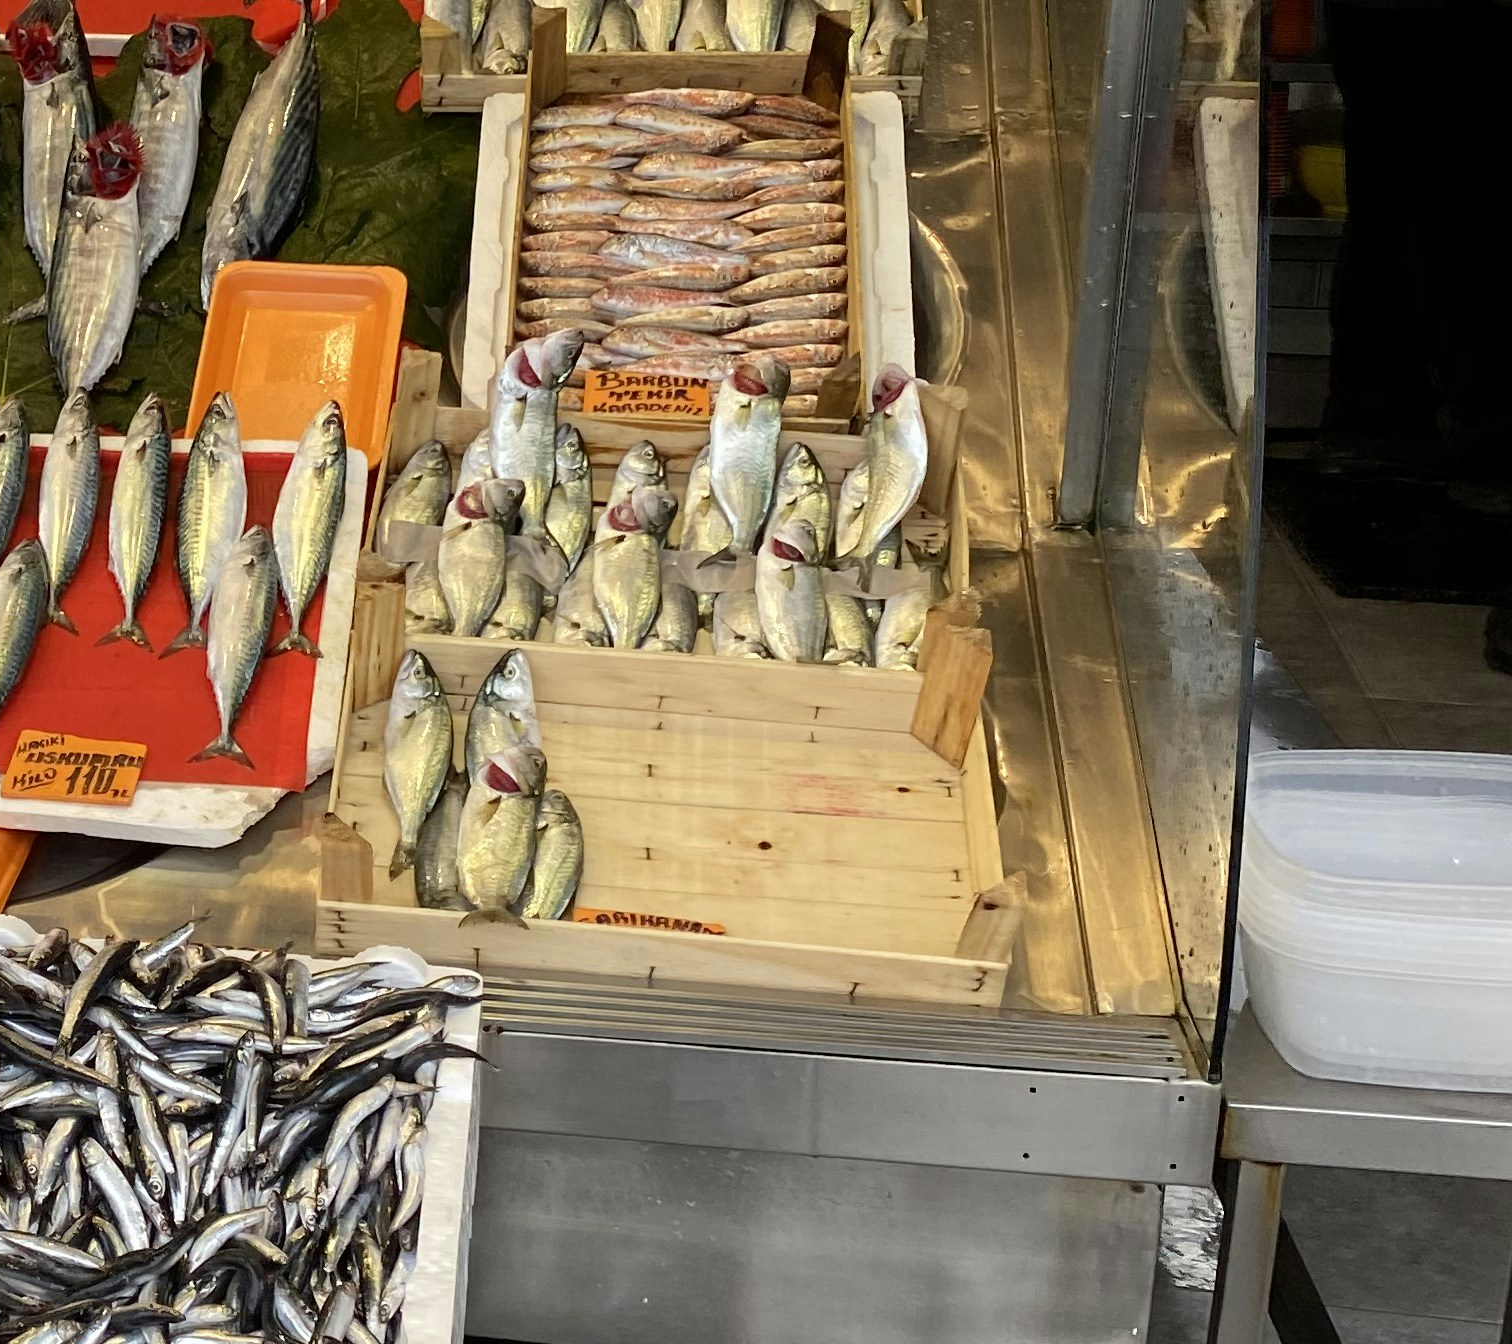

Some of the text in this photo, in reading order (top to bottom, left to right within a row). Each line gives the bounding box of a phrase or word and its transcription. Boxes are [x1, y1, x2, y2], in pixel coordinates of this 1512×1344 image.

[594, 372, 709, 391] BARBUN
[608, 388, 695, 402] TEKİR
[65, 766, 118, 796] 110
